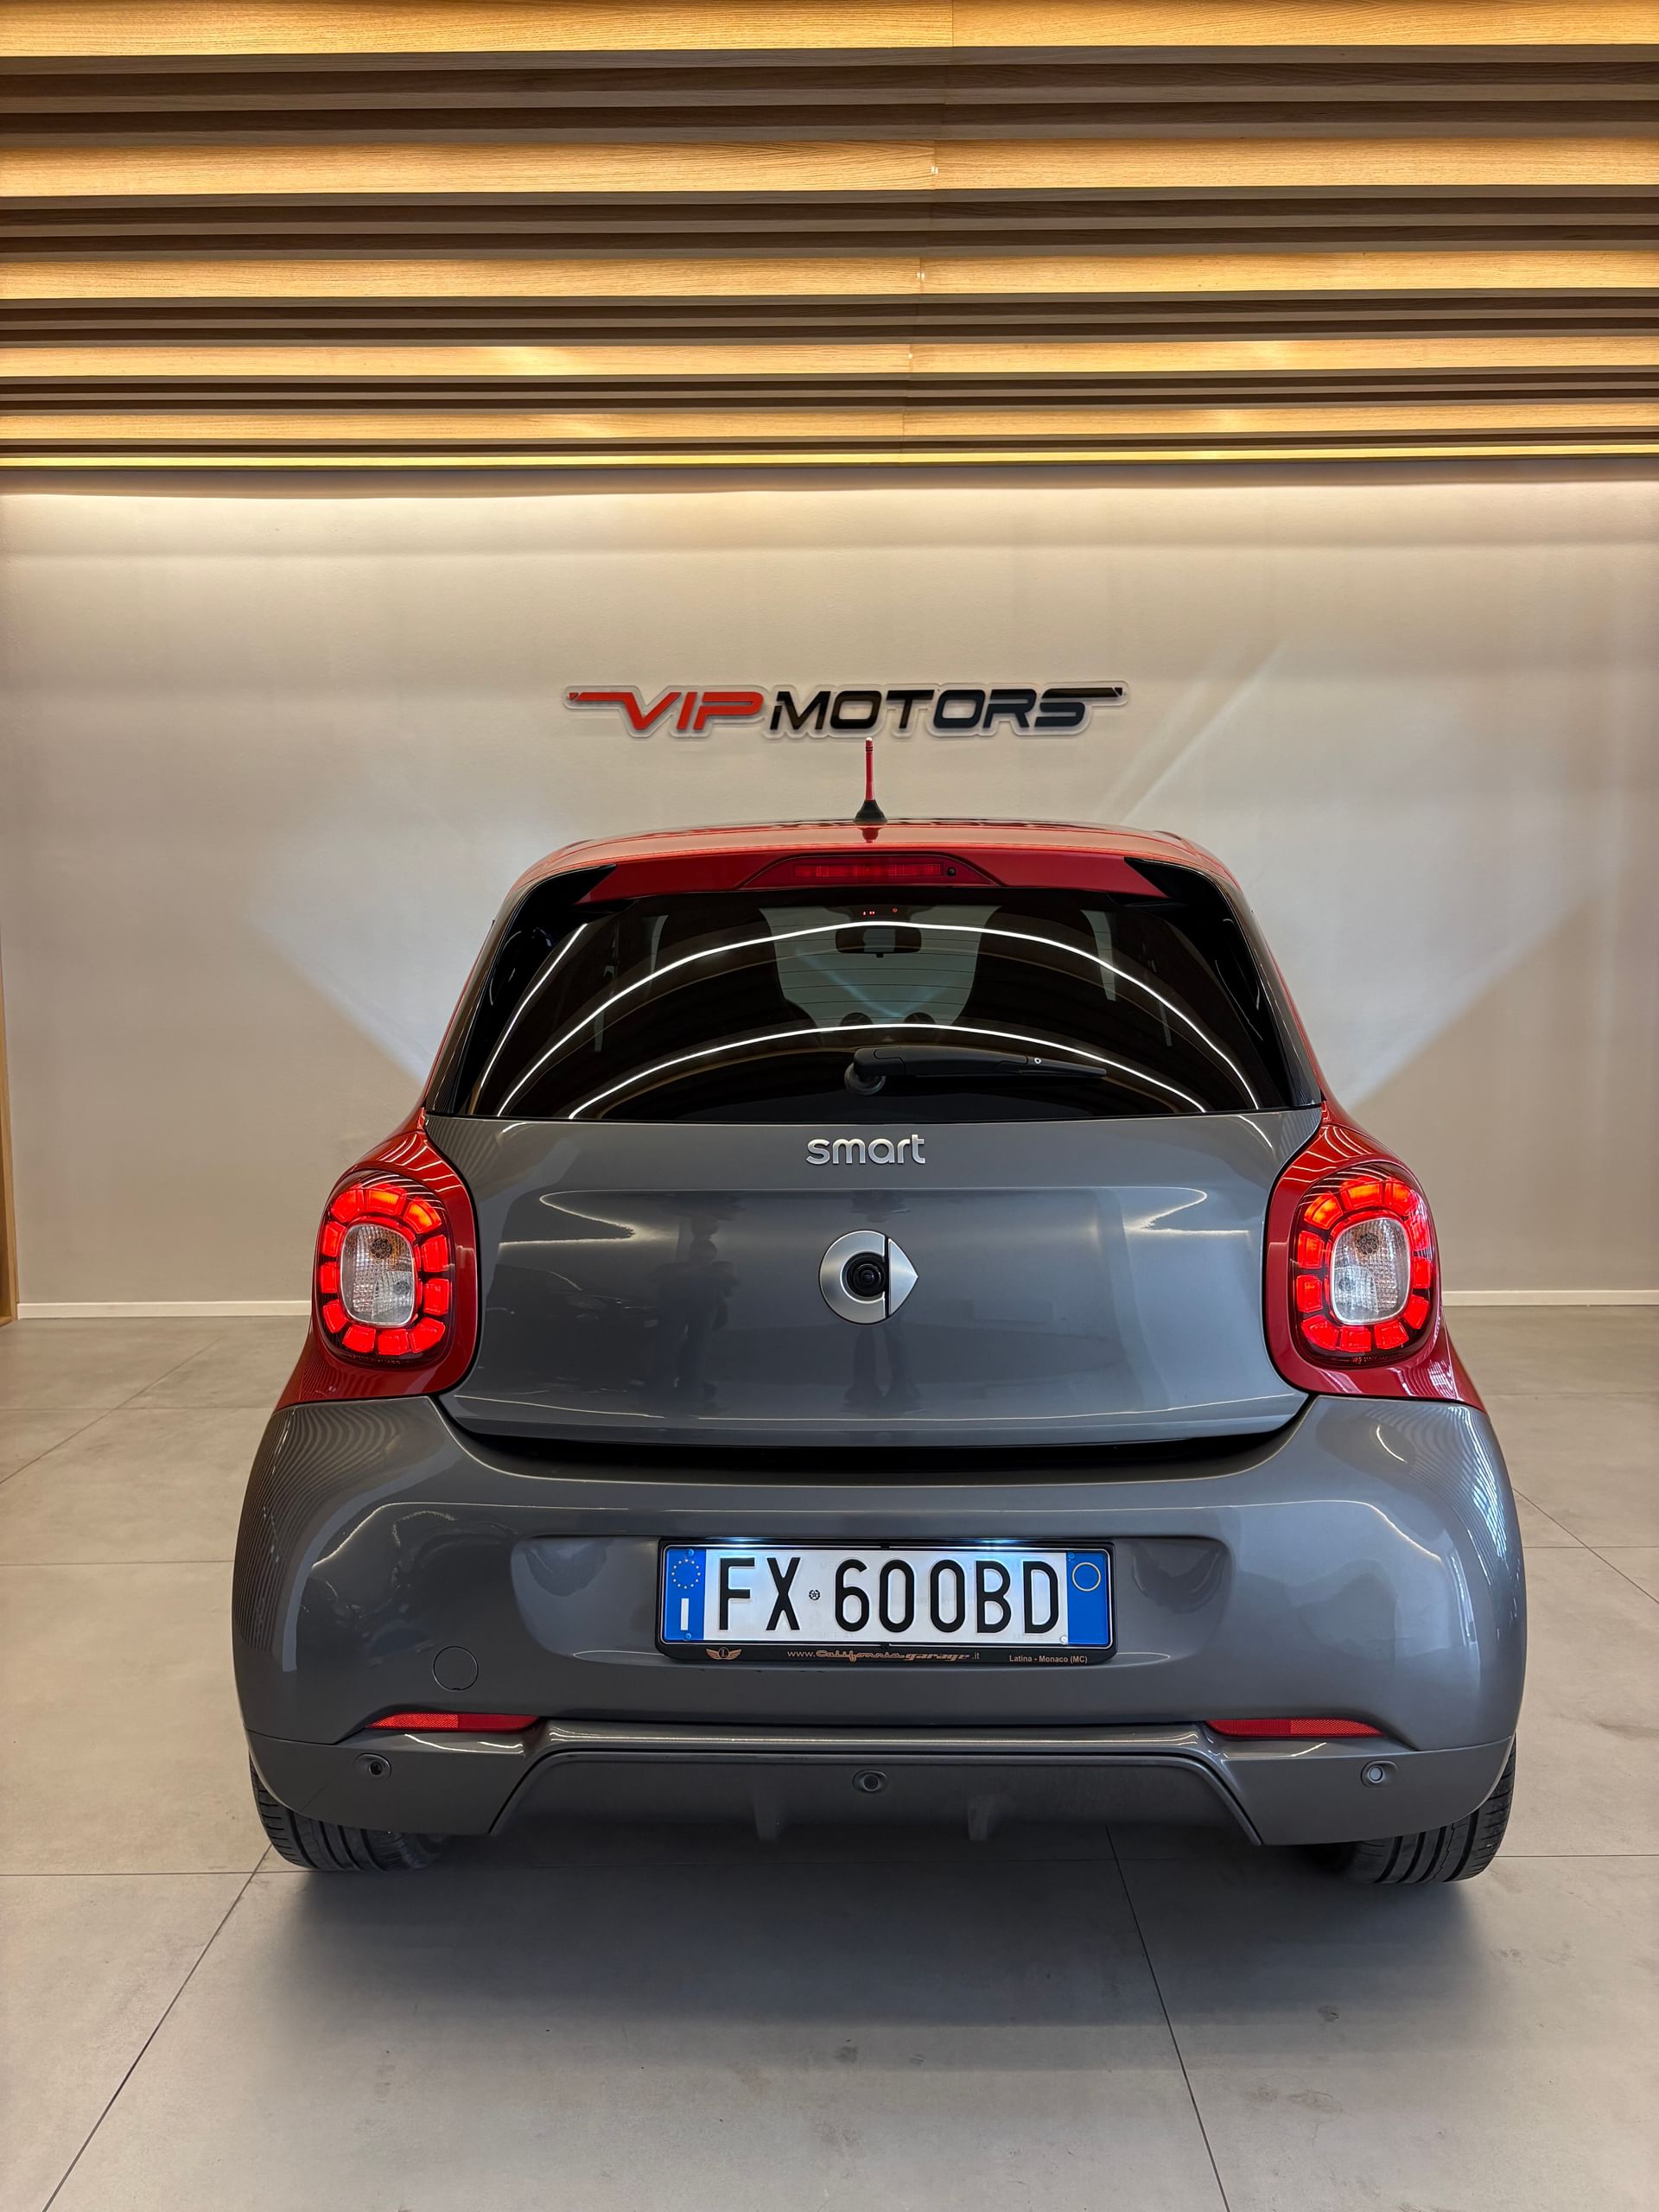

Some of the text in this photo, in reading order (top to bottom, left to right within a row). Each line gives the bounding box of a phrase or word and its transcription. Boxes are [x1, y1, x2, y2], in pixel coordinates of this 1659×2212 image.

[569, 687, 1122, 730] VIP MOTORS
[806, 1134, 925, 1165] smart
[719, 1557, 1058, 1634] FX 600BD
[1039, 1655, 1069, 1663] Monaco
[1070, 1656, 1088, 1664] (MC)
